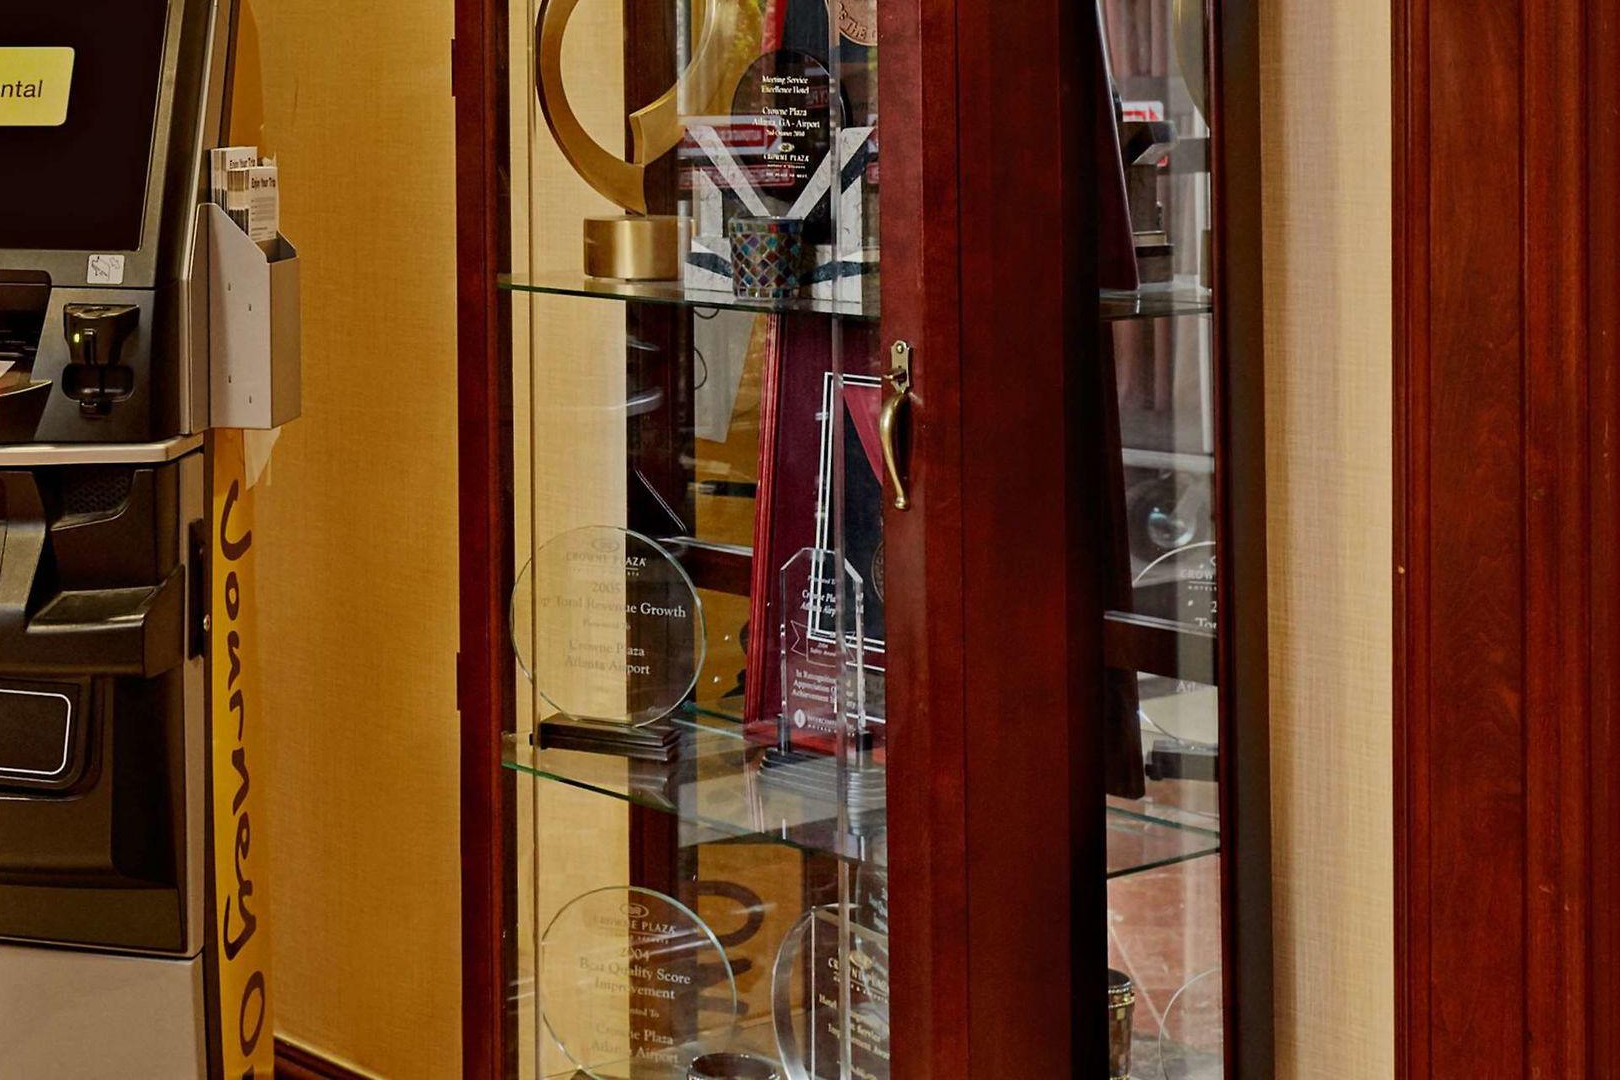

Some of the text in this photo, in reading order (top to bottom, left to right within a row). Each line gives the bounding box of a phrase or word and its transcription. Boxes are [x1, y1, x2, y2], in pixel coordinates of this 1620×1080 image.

[762, 75, 808, 85] Meeting Service
[761, 85, 792, 94] Excellence
[762, 106, 807, 117] Crowne Plaza
[779, 118, 791, 128] GA
[796, 119, 821, 131] Airport
[790, 153, 810, 163] PLAZA
[640, 602, 687, 619] Growth
[616, 643, 645, 657] Paza
[220, 479, 257, 961] Journey
[641, 921, 676, 935] PLAZA
[608, 959, 654, 981] Quality
[657, 969, 691, 985] Score
[643, 1028, 674, 1046] Plaza
[590, 1039, 679, 1064] Atlan Airport
